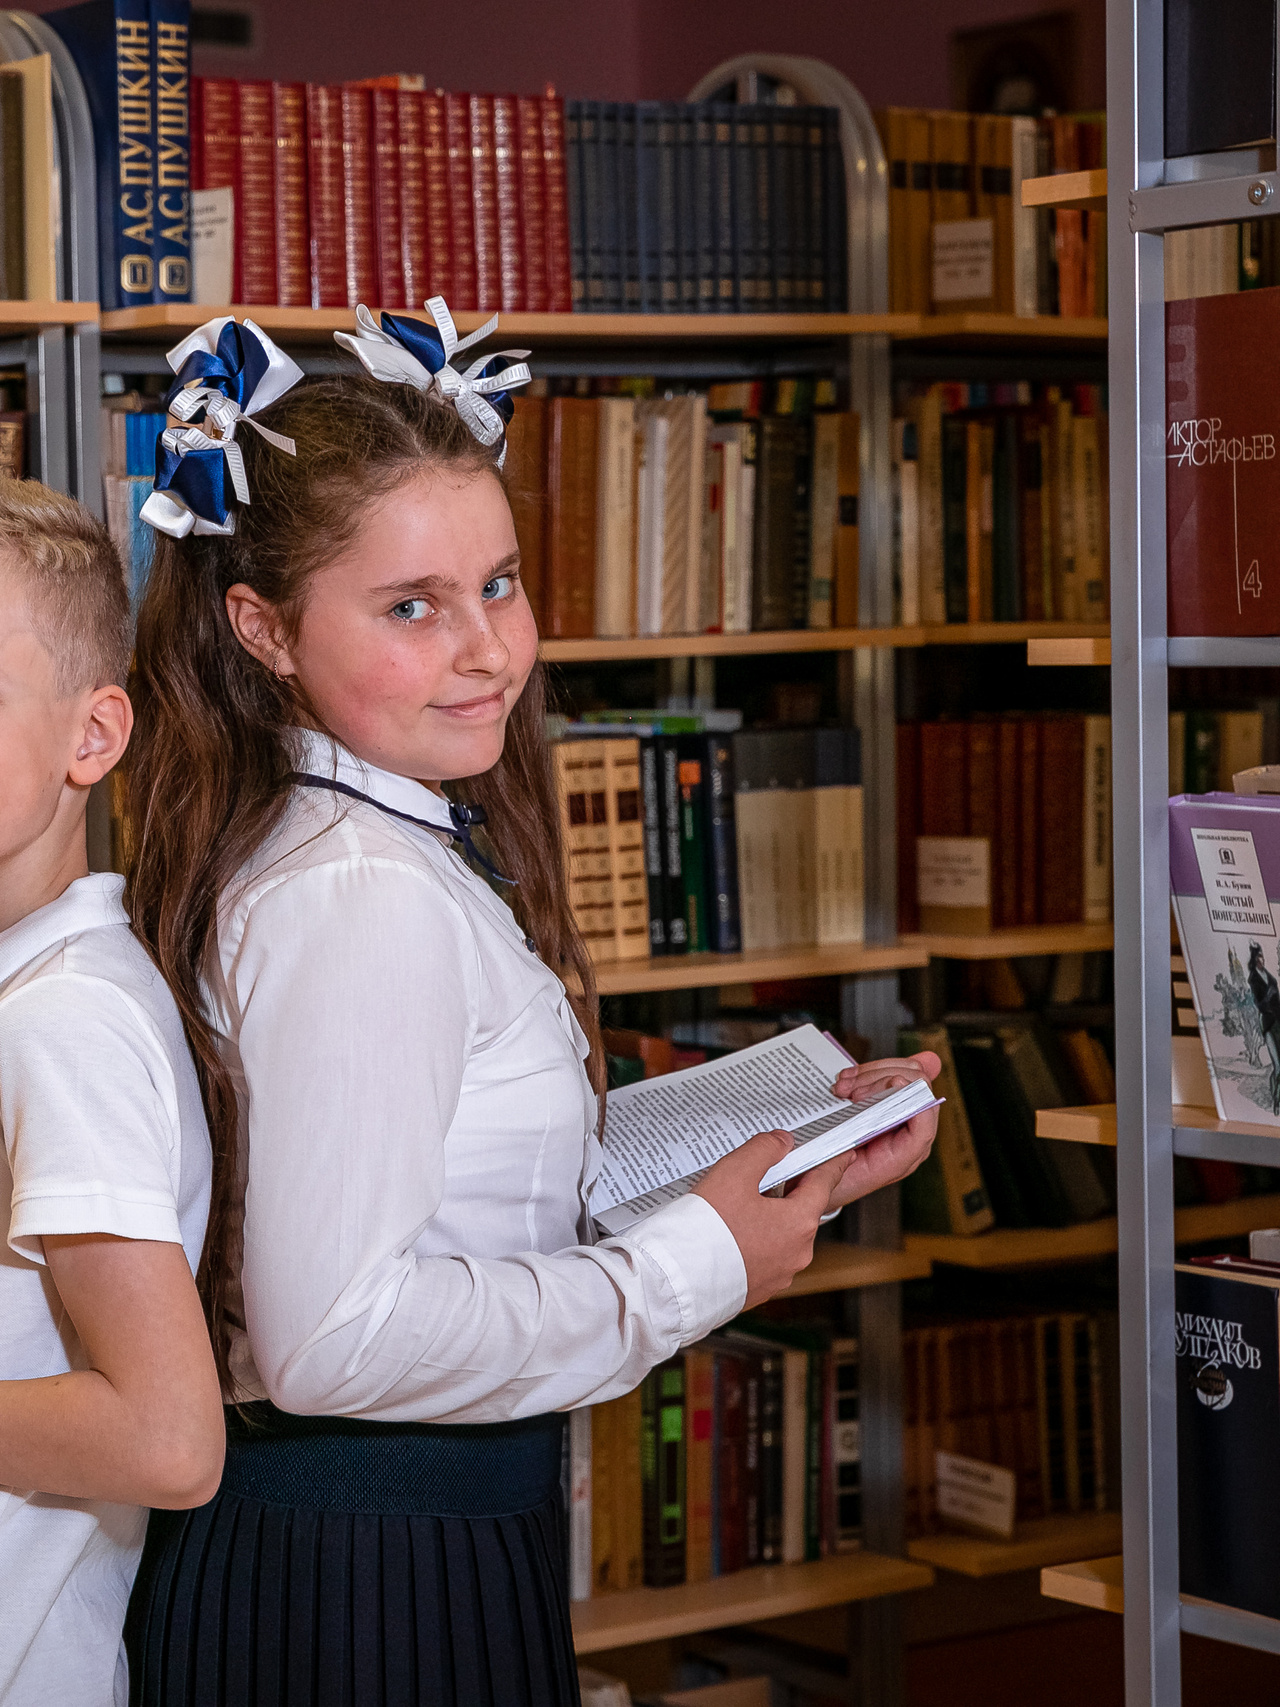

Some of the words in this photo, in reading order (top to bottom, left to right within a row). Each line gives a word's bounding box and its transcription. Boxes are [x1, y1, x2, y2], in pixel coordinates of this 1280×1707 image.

[1167, 418, 1222, 446] ИКТОР
[1177, 434, 1276, 467] АСТАФЬЕВ
[1243, 559, 1263, 598] 4
[1220, 895, 1255, 908] ЧИСТЫЙ
[1211, 910, 1271, 925] ПОНЕДЕЛЬНИК
[1175, 1332, 1262, 1370] УЛГАКОВ
